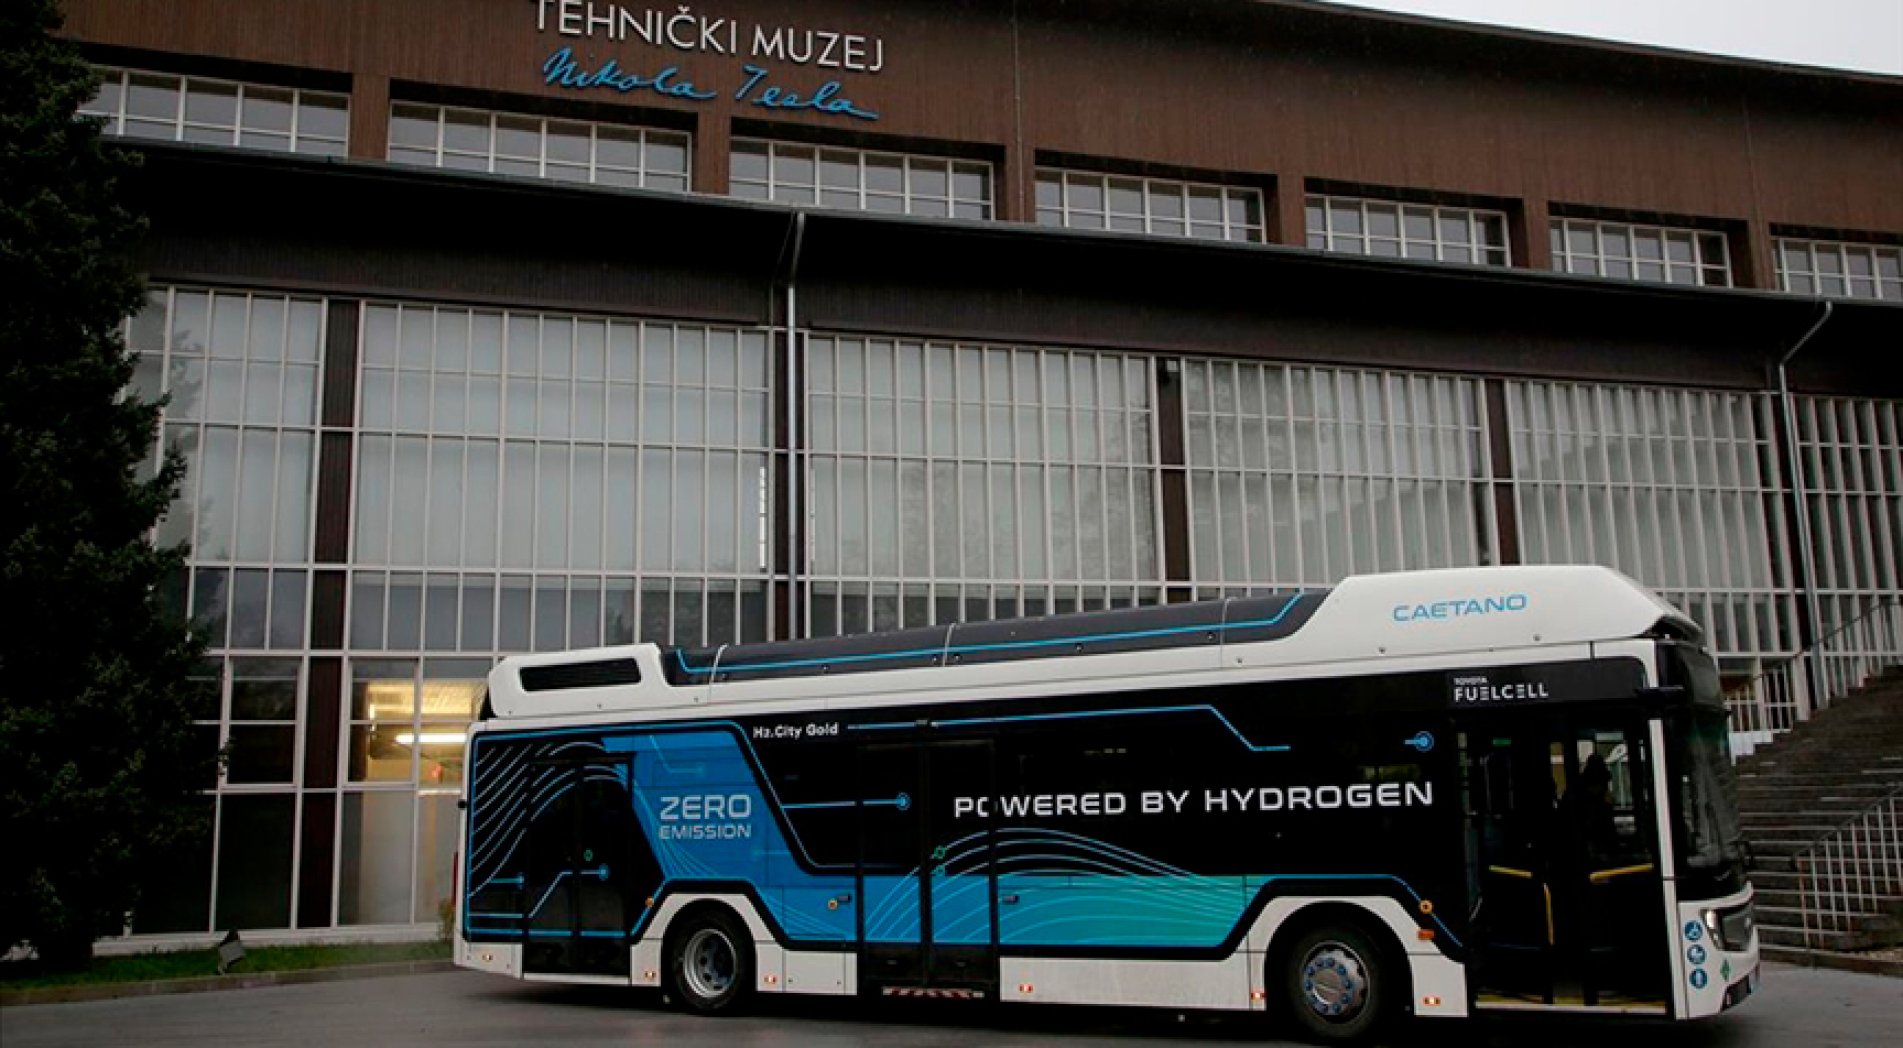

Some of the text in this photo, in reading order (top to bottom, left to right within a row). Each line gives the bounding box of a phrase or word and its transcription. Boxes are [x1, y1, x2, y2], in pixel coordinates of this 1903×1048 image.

[533, 0, 884, 72] TEHNIČKI MUZEJ
[543, 47, 880, 121] Nikola Tesla
[1393, 593, 1528, 622] CAETANO
[1454, 682, 1549, 702] FUELCELL
[805, 722, 840, 737] Gold
[660, 794, 752, 820] ZERO
[1140, 789, 1190, 814] BY
[1204, 781, 1433, 813] HYDROGEN
[659, 823, 752, 840] EMISSION
